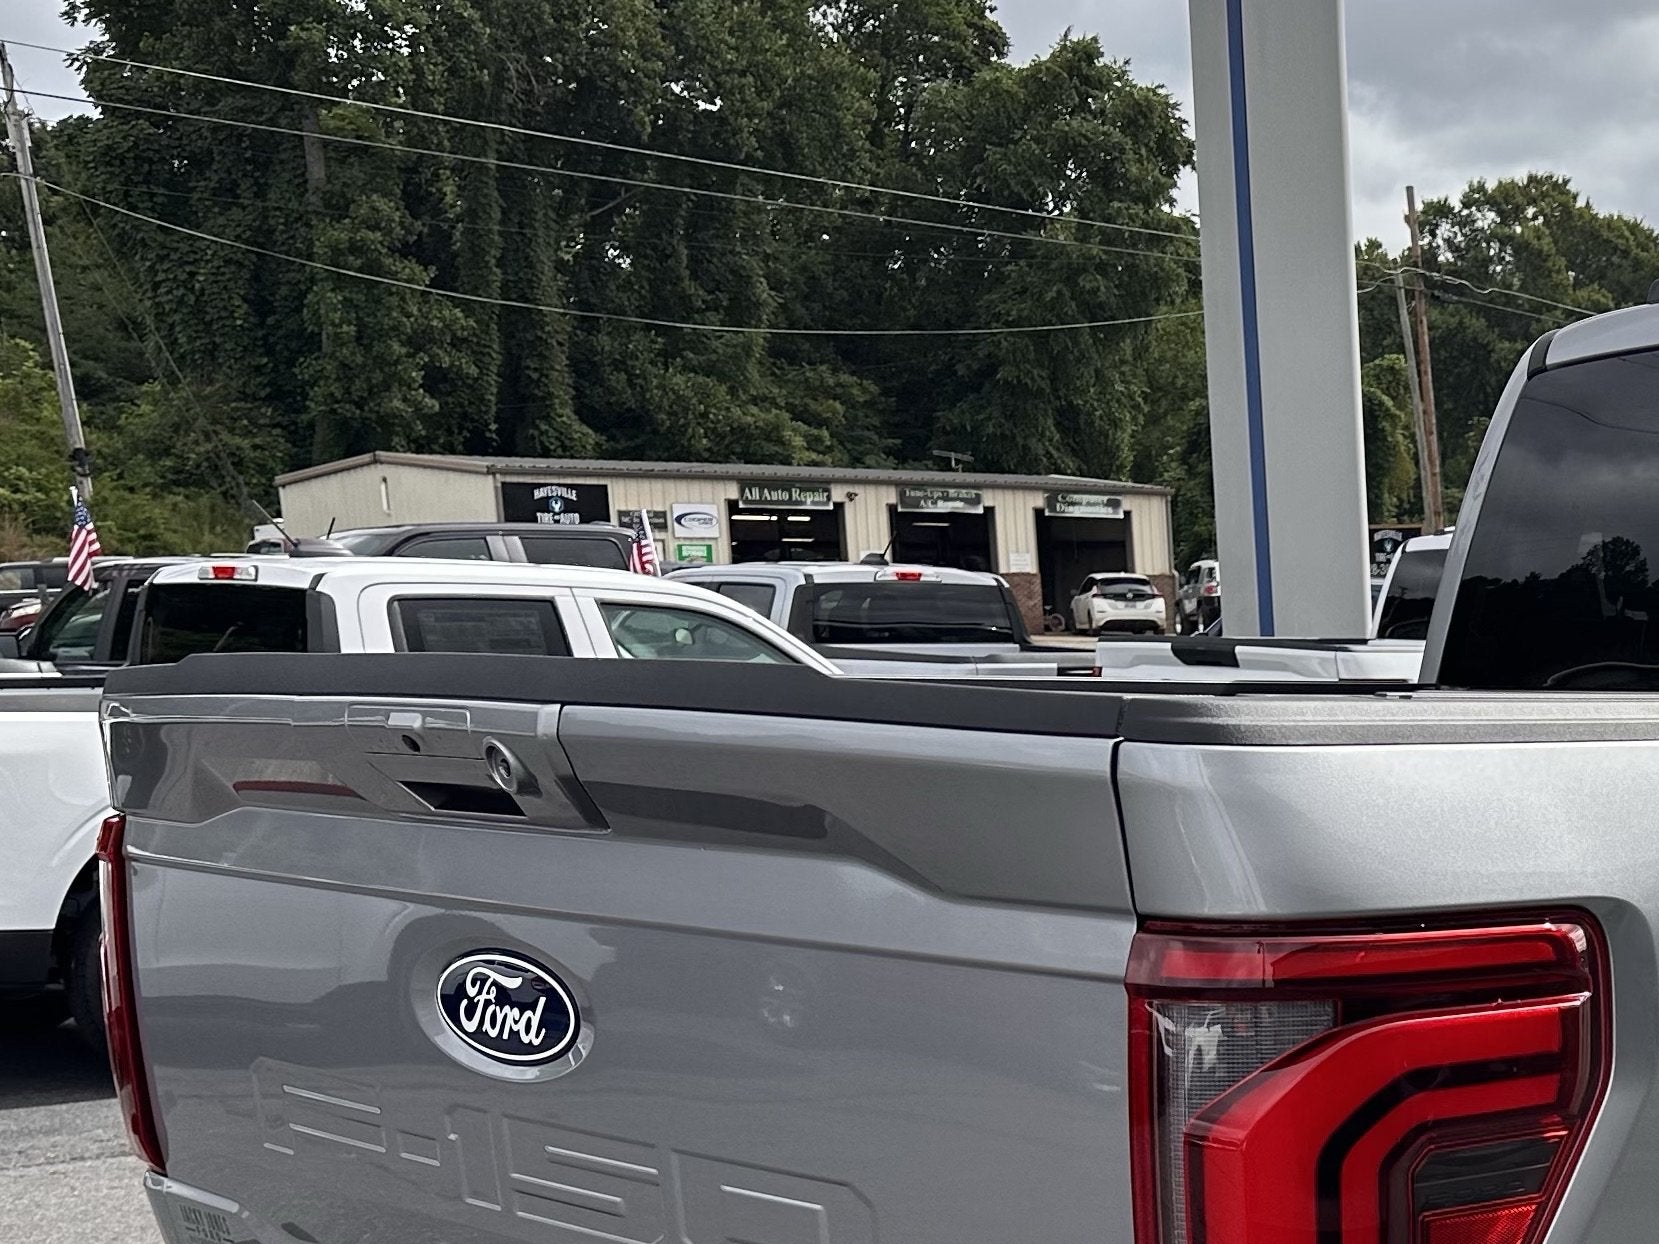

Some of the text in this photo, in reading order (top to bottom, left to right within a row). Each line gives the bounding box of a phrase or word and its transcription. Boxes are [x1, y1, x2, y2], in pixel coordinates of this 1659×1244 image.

[533, 485, 577, 501] HAYESVILLE
[742, 487, 828, 505] All Auto Repair
[459, 966, 546, 1046] Ford
